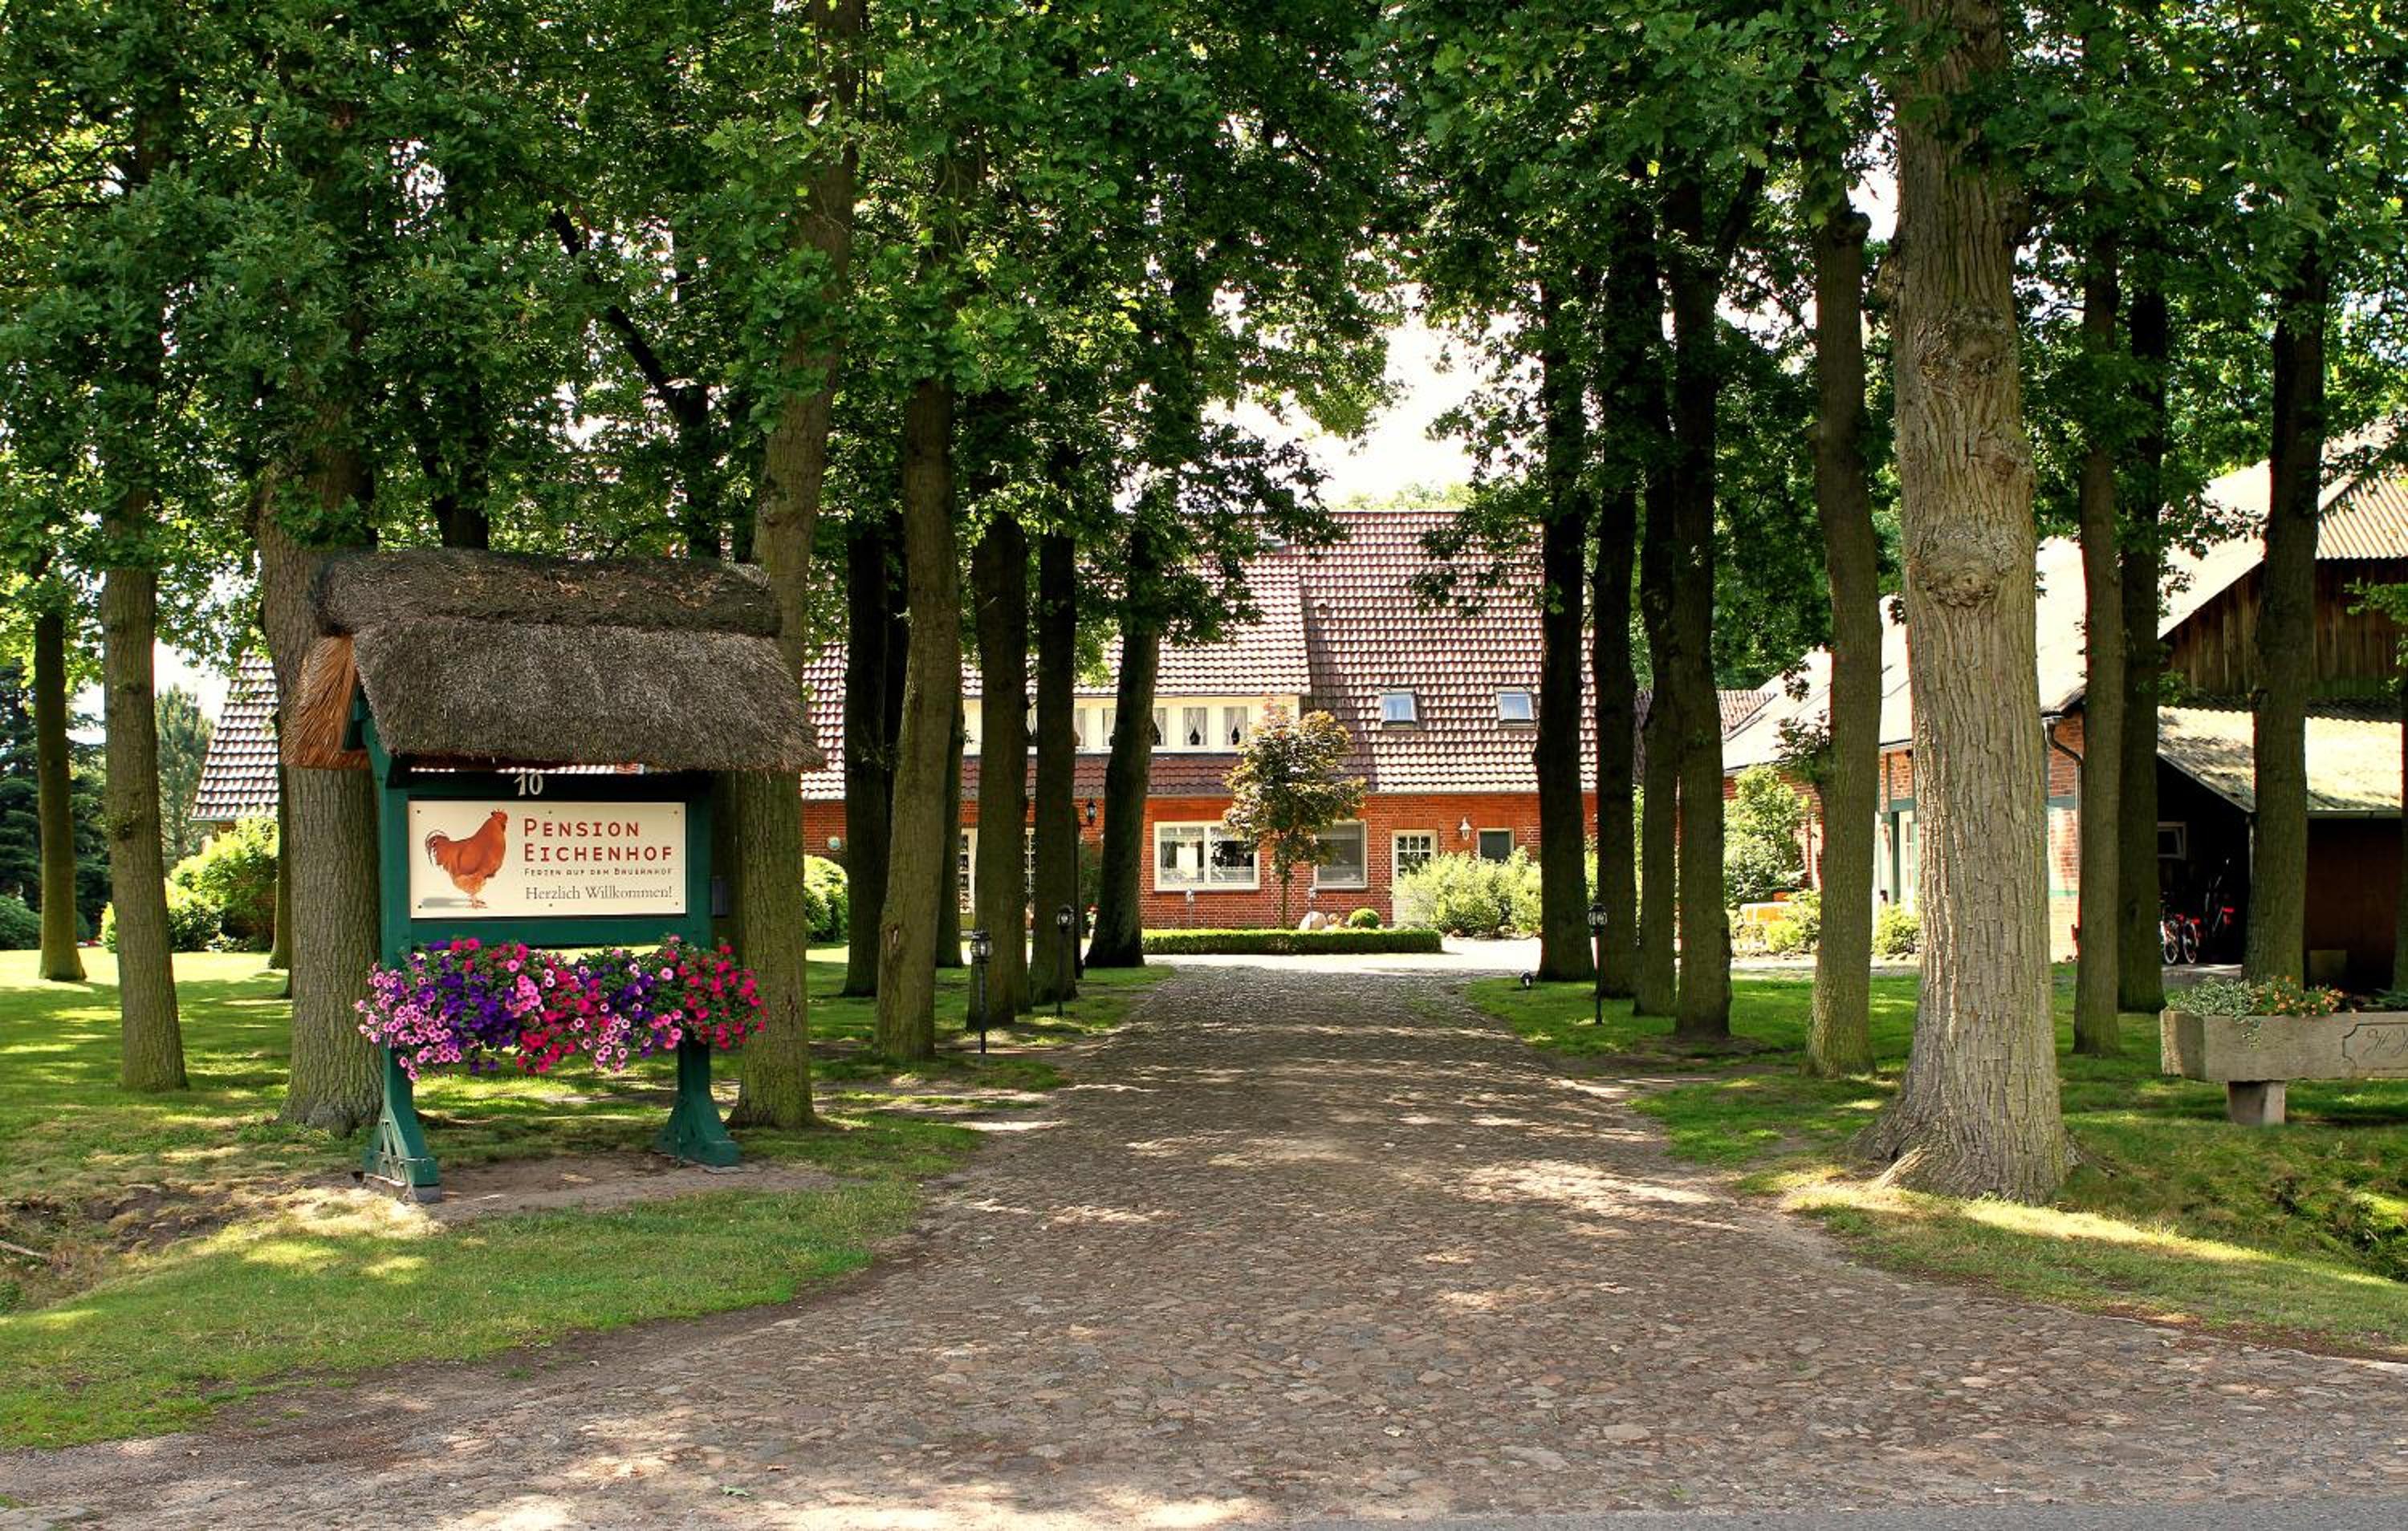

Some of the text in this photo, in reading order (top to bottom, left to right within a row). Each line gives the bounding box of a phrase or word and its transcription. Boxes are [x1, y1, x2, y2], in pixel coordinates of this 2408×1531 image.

[514, 772, 543, 796] 10
[524, 818, 639, 837] PENSION
[524, 843, 672, 862] EICHENHOF
[526, 884, 673, 900] Herzlich Willkommen!
